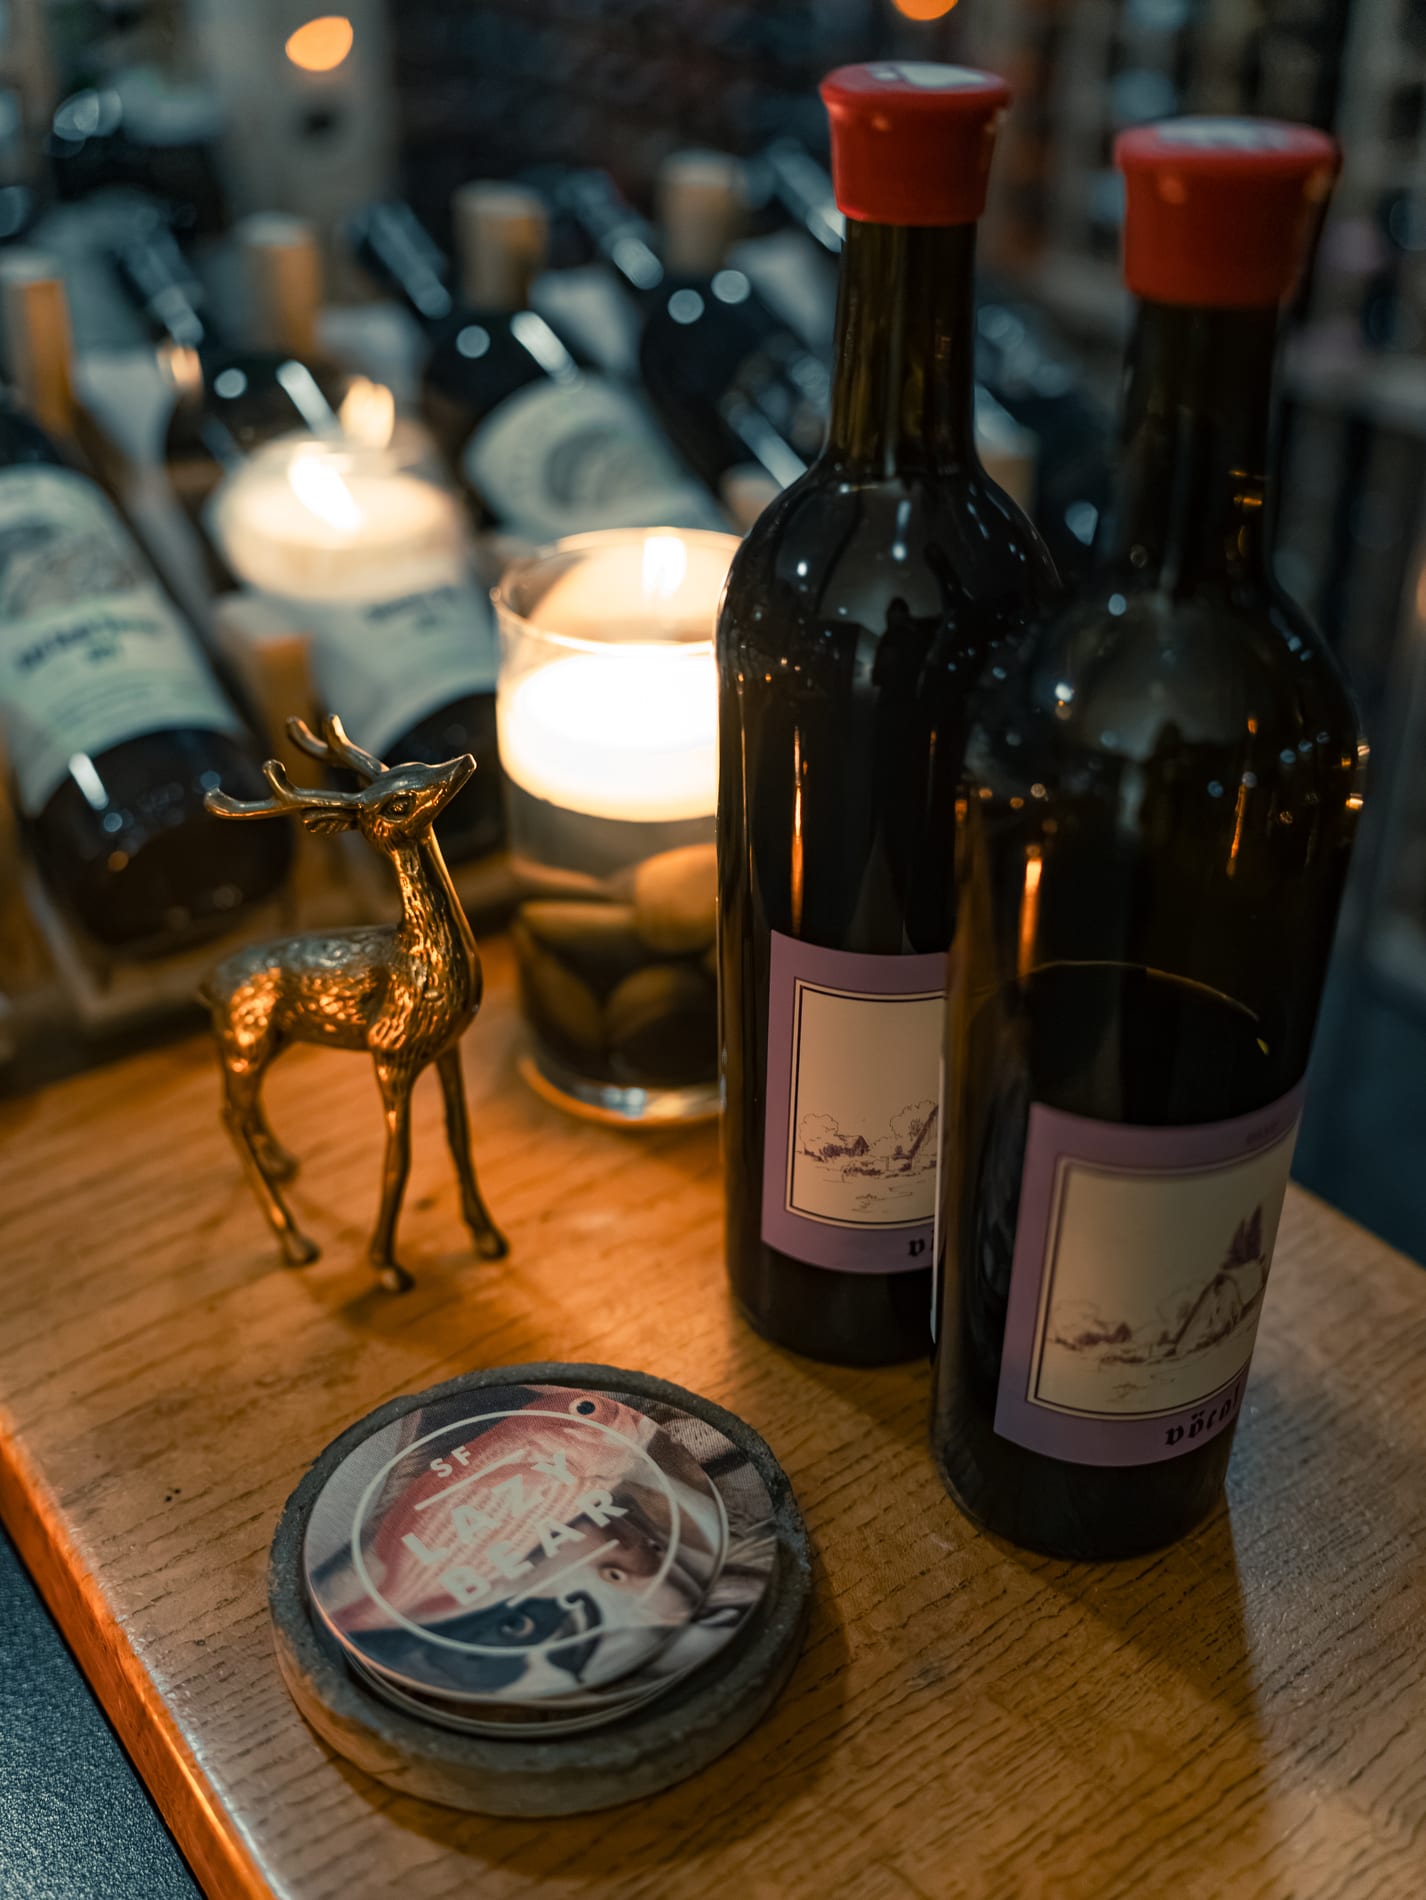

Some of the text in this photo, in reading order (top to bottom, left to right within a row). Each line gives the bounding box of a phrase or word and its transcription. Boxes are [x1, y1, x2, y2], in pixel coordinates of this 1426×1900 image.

[402, 1450, 577, 1564] LAZY
[430, 1445, 472, 1478] SF
[439, 1489, 629, 1606] BEAR
